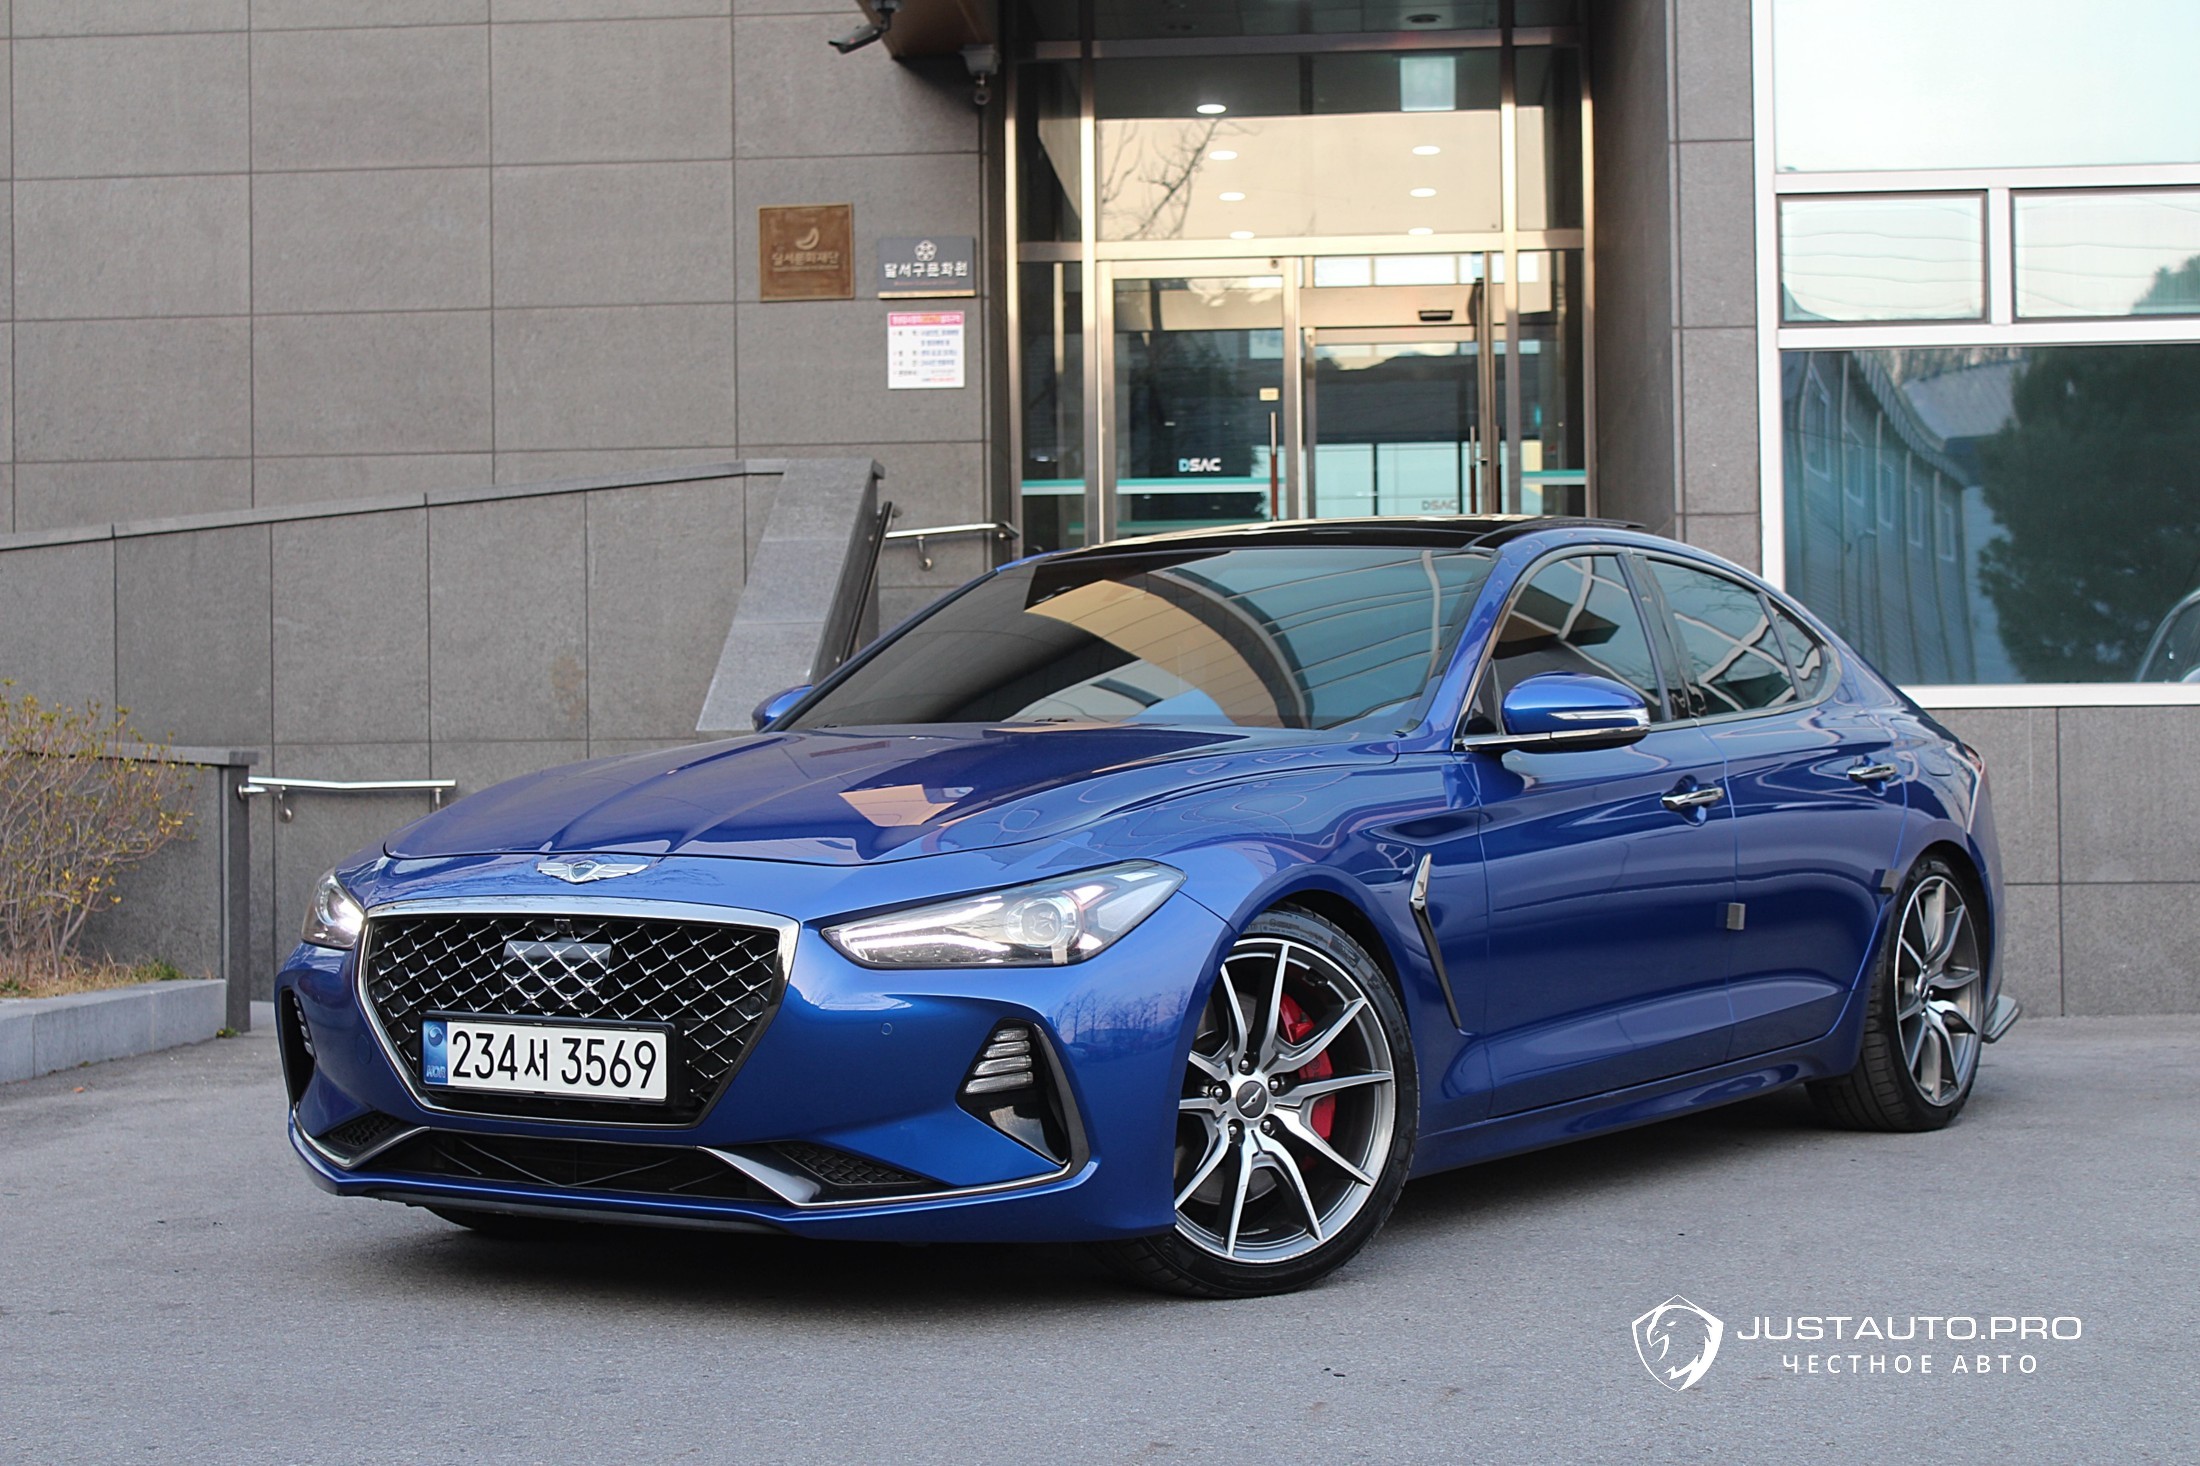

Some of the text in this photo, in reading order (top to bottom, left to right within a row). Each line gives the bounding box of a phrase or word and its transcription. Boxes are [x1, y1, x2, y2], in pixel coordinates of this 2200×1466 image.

[884, 261, 968, 279] 달서구문화원
[1178, 458, 1221, 472] DSAC
[1421, 500, 1459, 511] DSAC
[452, 1030, 657, 1089] 234서 3569
